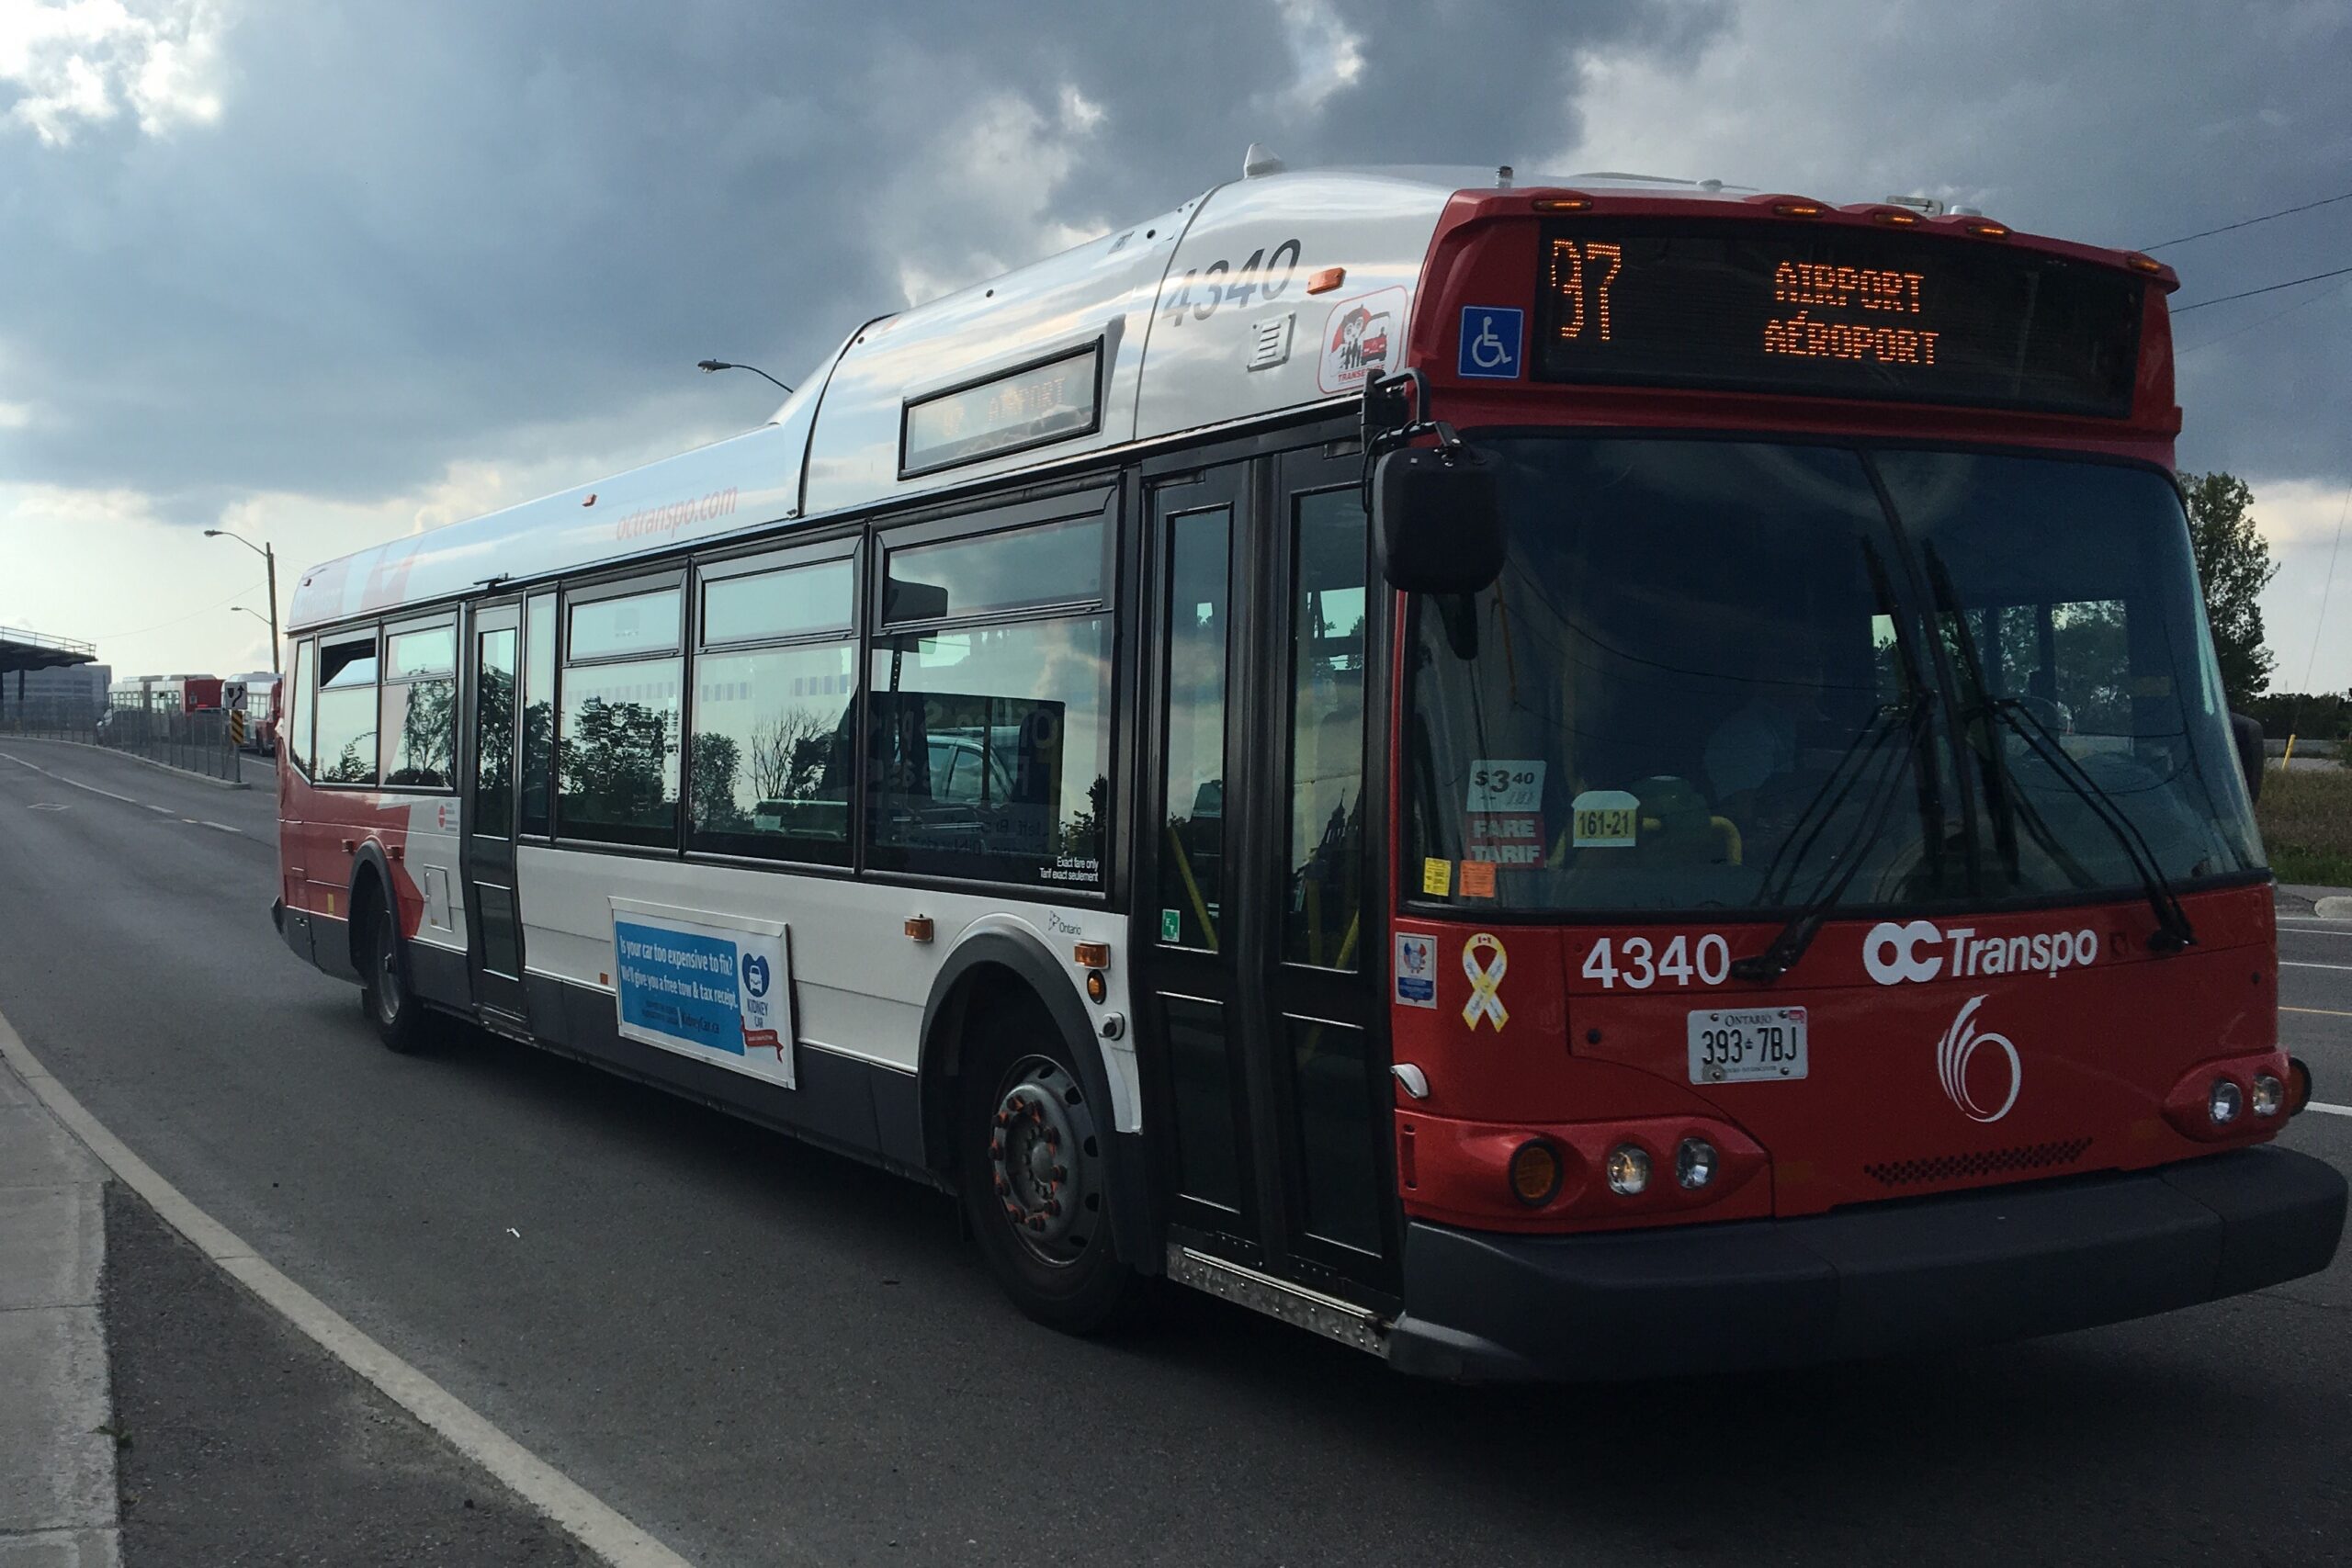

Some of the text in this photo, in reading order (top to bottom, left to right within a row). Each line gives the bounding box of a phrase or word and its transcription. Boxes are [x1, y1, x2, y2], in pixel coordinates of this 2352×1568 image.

[1162, 238, 1301, 327] 4340
[1551, 239, 1622, 340] 97
[1775, 261, 1925, 313] AIRPORT
[1764, 310, 1940, 366] AÉROPORT
[616, 486, 738, 540] octranspo.com
[1473, 819, 1536, 838] FARE
[1578, 811, 1629, 836] 161-21
[1057, 856, 1073, 868] Exact
[1086, 858, 1099, 872] only
[1471, 845, 1541, 863] TARIF
[1068, 870, 1099, 882] seulement
[1059, 921, 1082, 935] Ontario
[619, 935, 733, 976] Is your car too expensive to fix?
[1582, 933, 1731, 989] 4340
[1862, 919, 2098, 986] OC Transpo
[635, 969, 648, 988] give
[647, 975, 660, 991] you
[659, 976, 664, 991] a
[663, 975, 678, 995] free
[678, 979, 693, 998] tow
[692, 981, 700, 998] &
[700, 984, 714, 1001] tax
[1702, 1029, 1743, 1066] 393
